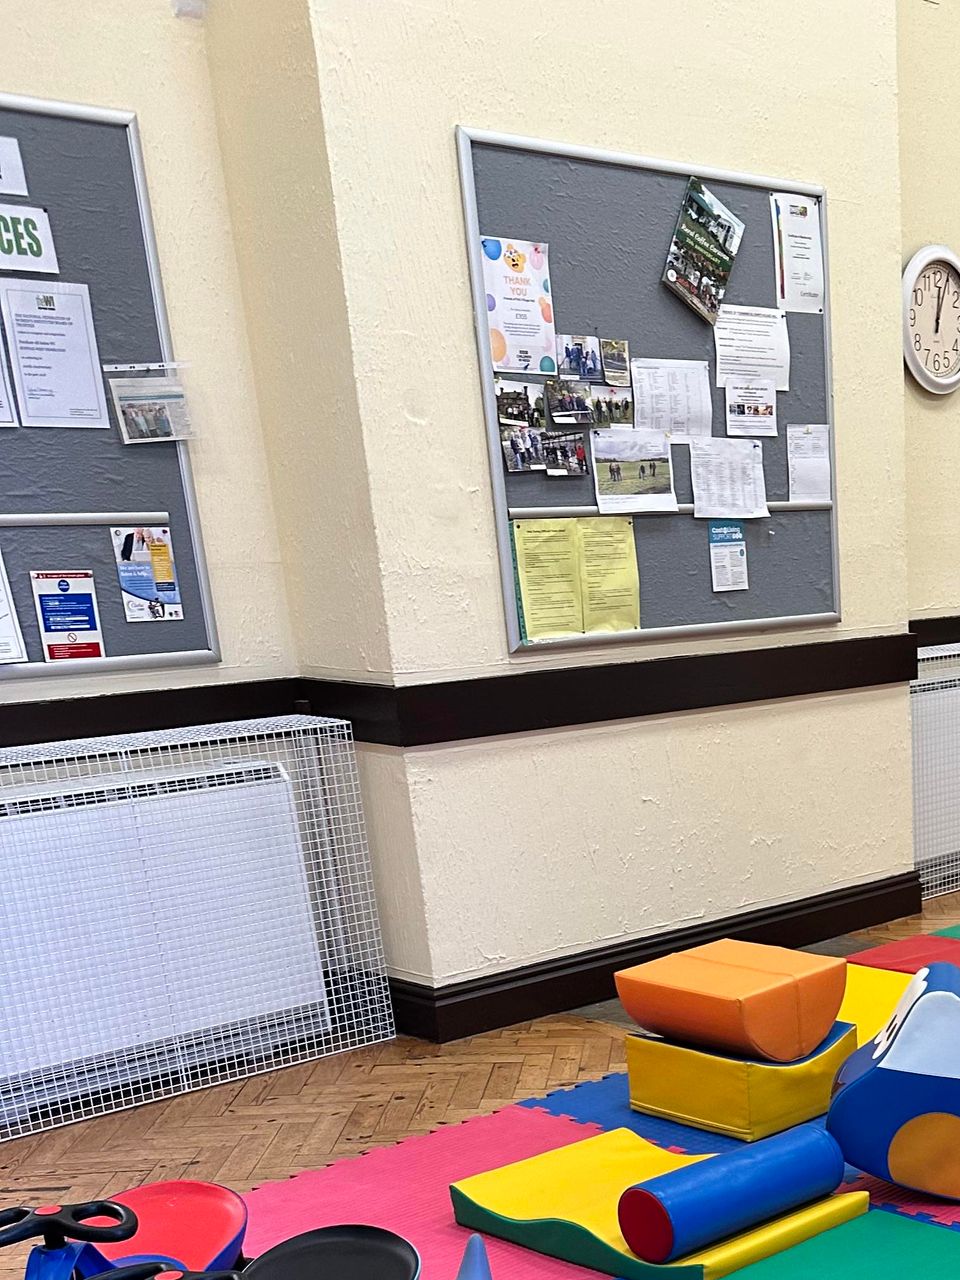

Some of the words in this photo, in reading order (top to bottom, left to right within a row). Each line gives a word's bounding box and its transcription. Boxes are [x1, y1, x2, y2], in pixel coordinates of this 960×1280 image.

[681, 223, 695, 238] Rural
[694, 233, 711, 248] Coffee
[709, 244, 730, 261] Caravan
[503, 276, 531, 286] THANK
[922, 274, 931, 292] 11
[932, 270, 943, 289] 12
[510, 287, 527, 296] YOU
[912, 287, 924, 307] 10
[952, 290, 960, 309] 2
[909, 308, 916, 327] 9
[914, 333, 922, 352] 8
[952, 338, 959, 356] 4
[924, 348, 931, 367] 7
[933, 353, 941, 371] 6
[943, 350, 950, 369] 5
